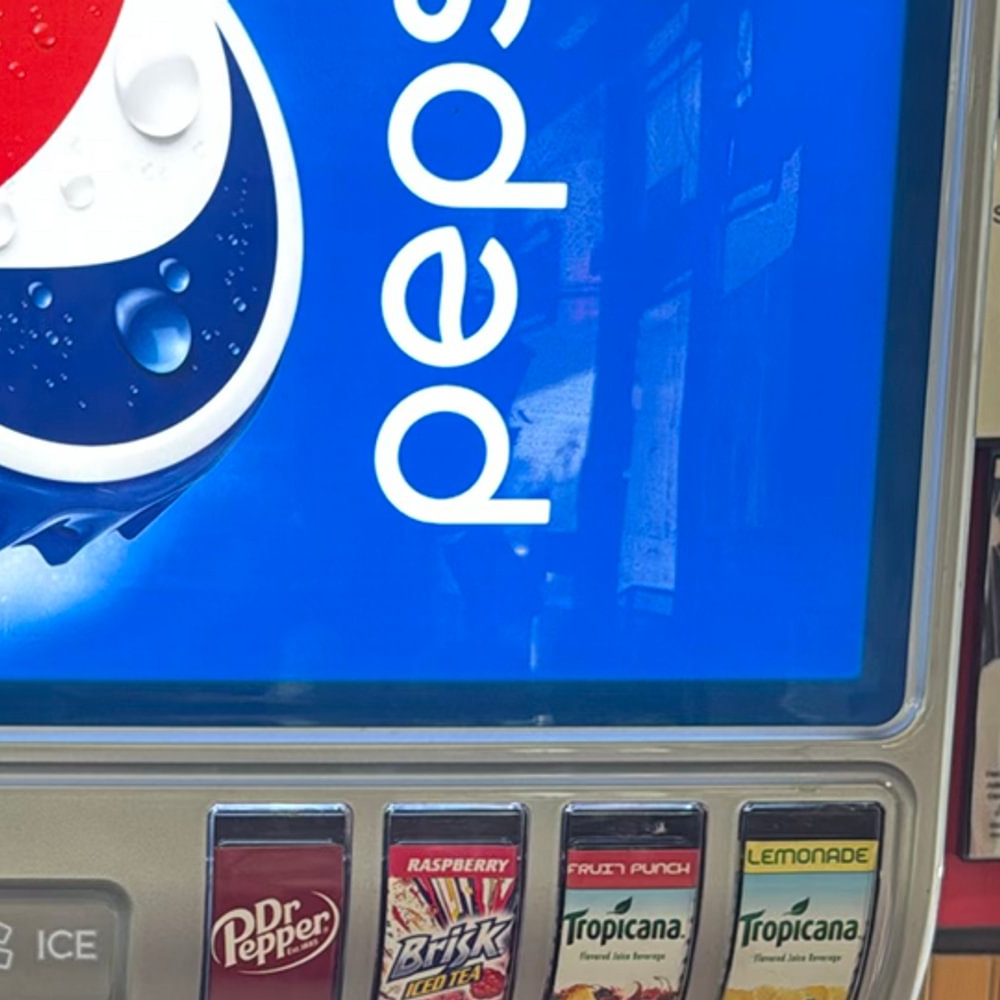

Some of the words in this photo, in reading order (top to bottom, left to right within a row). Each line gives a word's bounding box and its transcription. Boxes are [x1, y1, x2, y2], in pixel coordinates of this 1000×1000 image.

[407, 858, 509, 872] RASPBERRY
[567, 862, 626, 875] FRUIT
[630, 863, 690, 875] PUNCH
[748, 848, 869, 865] LEMONADE
[255, 898, 301, 935] Dr
[563, 908, 682, 946] Tropicana
[739, 908, 860, 947] Tropicana
[37, 929, 98, 960] ICE
[211, 908, 331, 968] Pepper
[401, 973, 446, 1000] ICED
[449, 963, 483, 988] TEA
